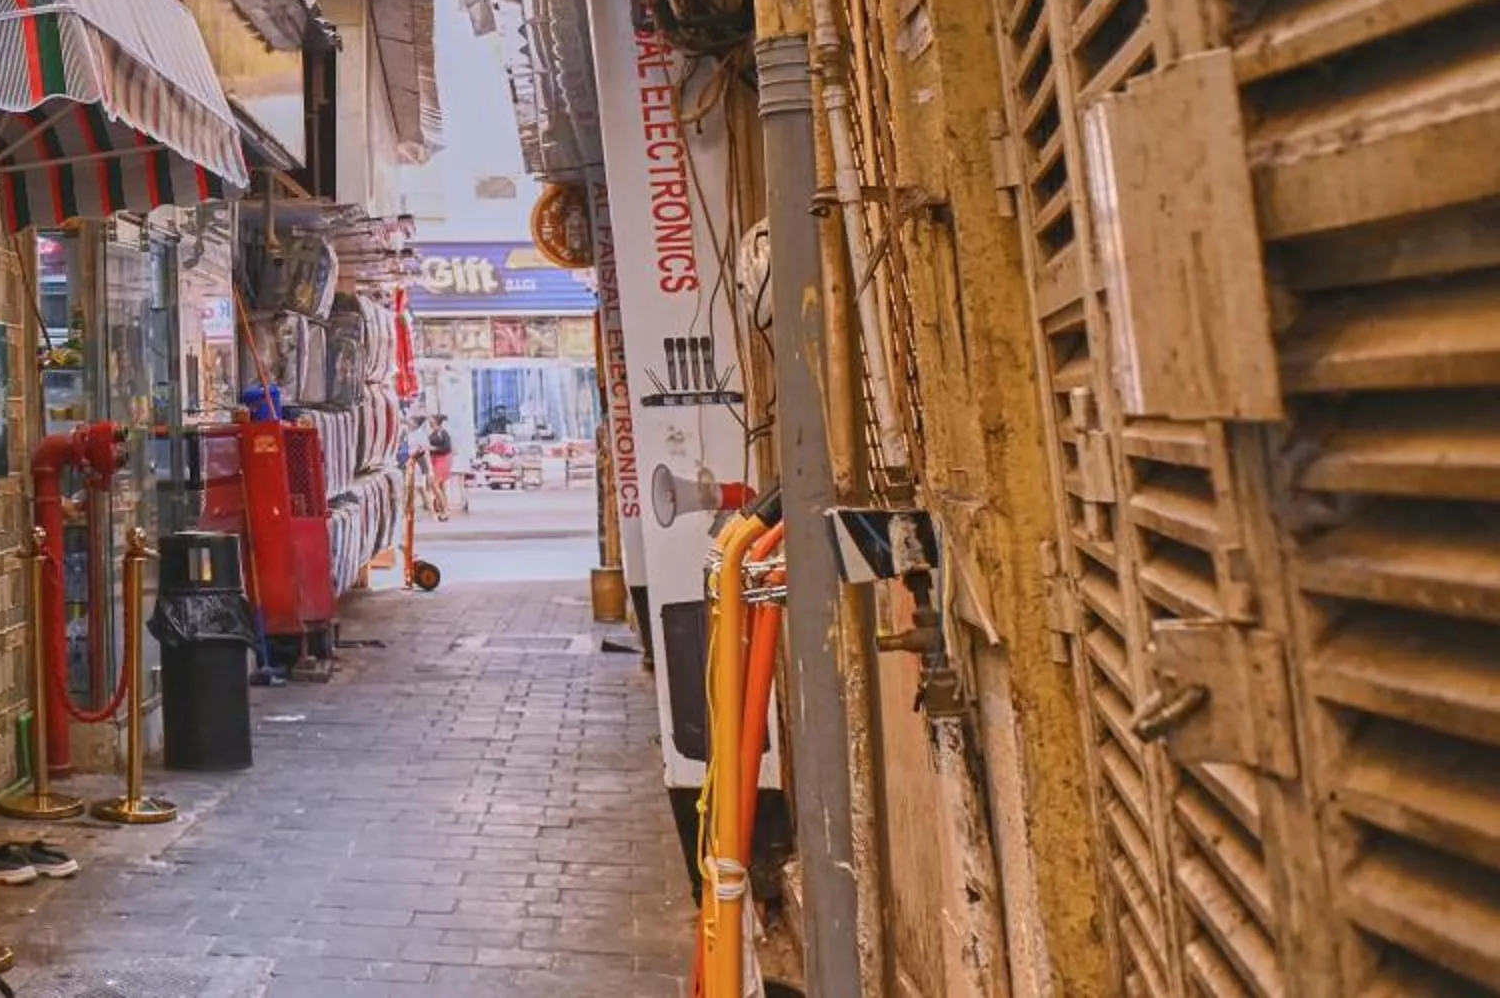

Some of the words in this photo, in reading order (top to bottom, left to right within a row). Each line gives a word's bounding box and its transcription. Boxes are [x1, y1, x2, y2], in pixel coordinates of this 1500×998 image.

[640, 85, 699, 294] ELECTRONICS
[421, 256, 498, 294] Gift
[597, 226, 621, 320] FAISAL
[607, 329, 641, 518] ELECTRONICS
